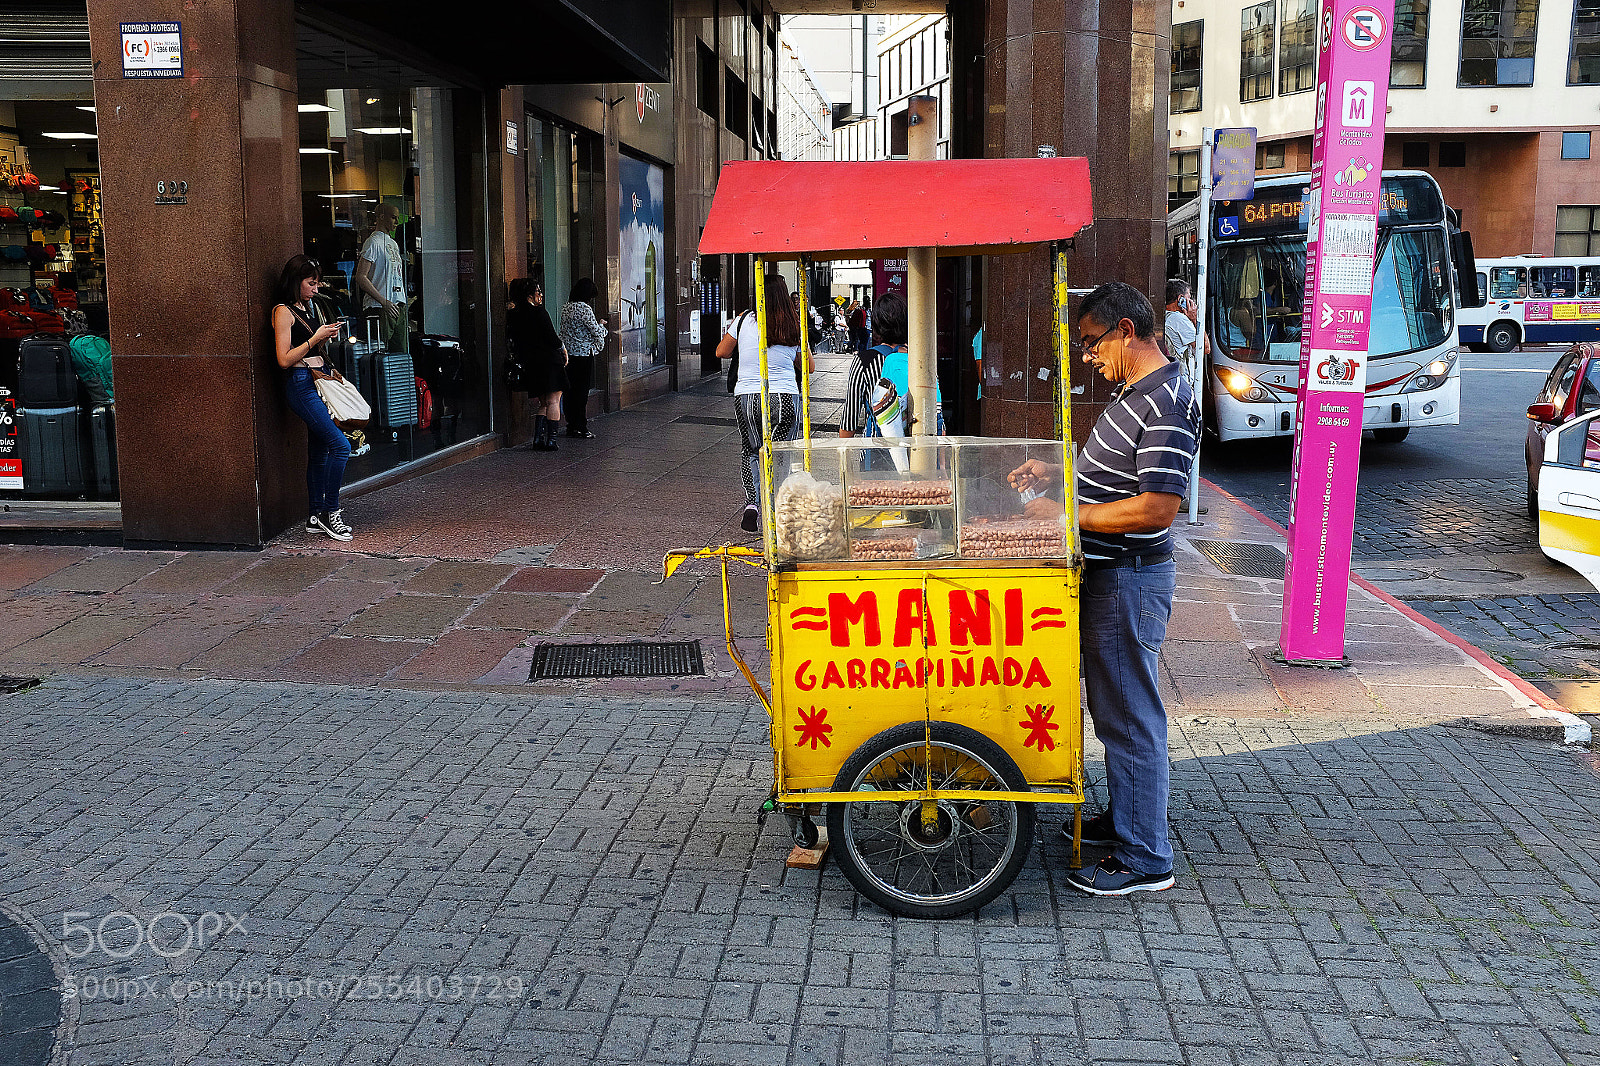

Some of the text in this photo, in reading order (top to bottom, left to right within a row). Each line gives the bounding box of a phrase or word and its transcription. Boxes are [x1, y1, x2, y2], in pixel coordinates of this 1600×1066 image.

[1218, 133, 1252, 149] PARADA
[1340, 130, 1373, 138] Montevideo
[1331, 188, 1344, 197] Bus
[1244, 203, 1268, 223] 64
[1337, 310, 1364, 324] STM
[1274, 375, 1286, 384] 31
[1312, 441, 1338, 635] www.busturisticomontevideo.com.uy
[828, 588, 1023, 647] MANI
[795, 649, 1051, 692] GARRAPIÑADA
